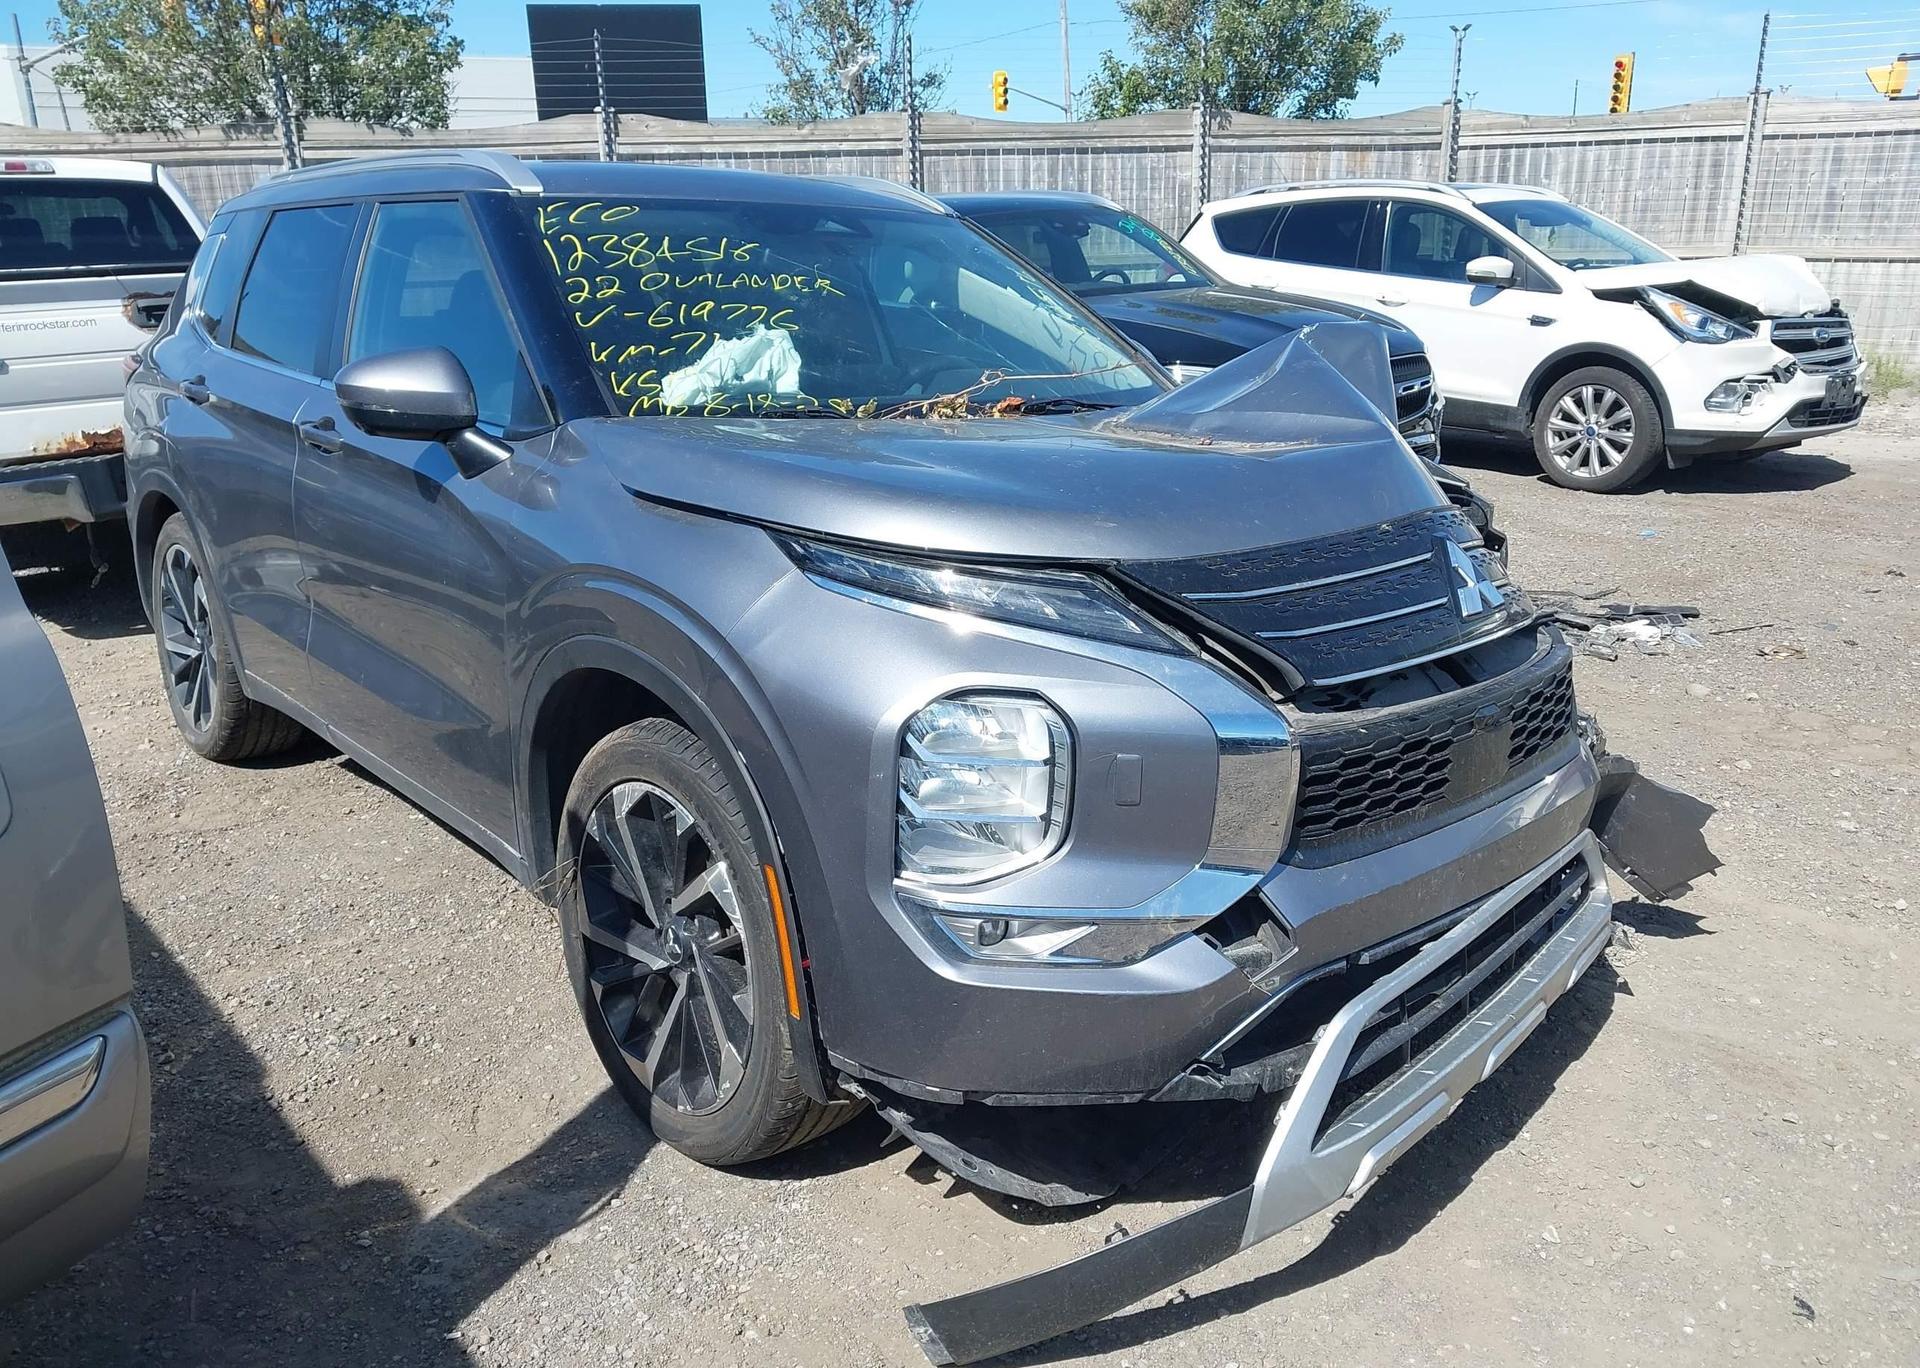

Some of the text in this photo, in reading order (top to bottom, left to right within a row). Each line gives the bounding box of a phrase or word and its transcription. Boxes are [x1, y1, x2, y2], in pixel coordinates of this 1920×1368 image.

[537, 201, 640, 233] ECO
[565, 264, 846, 304] 22 OUTLANDER
